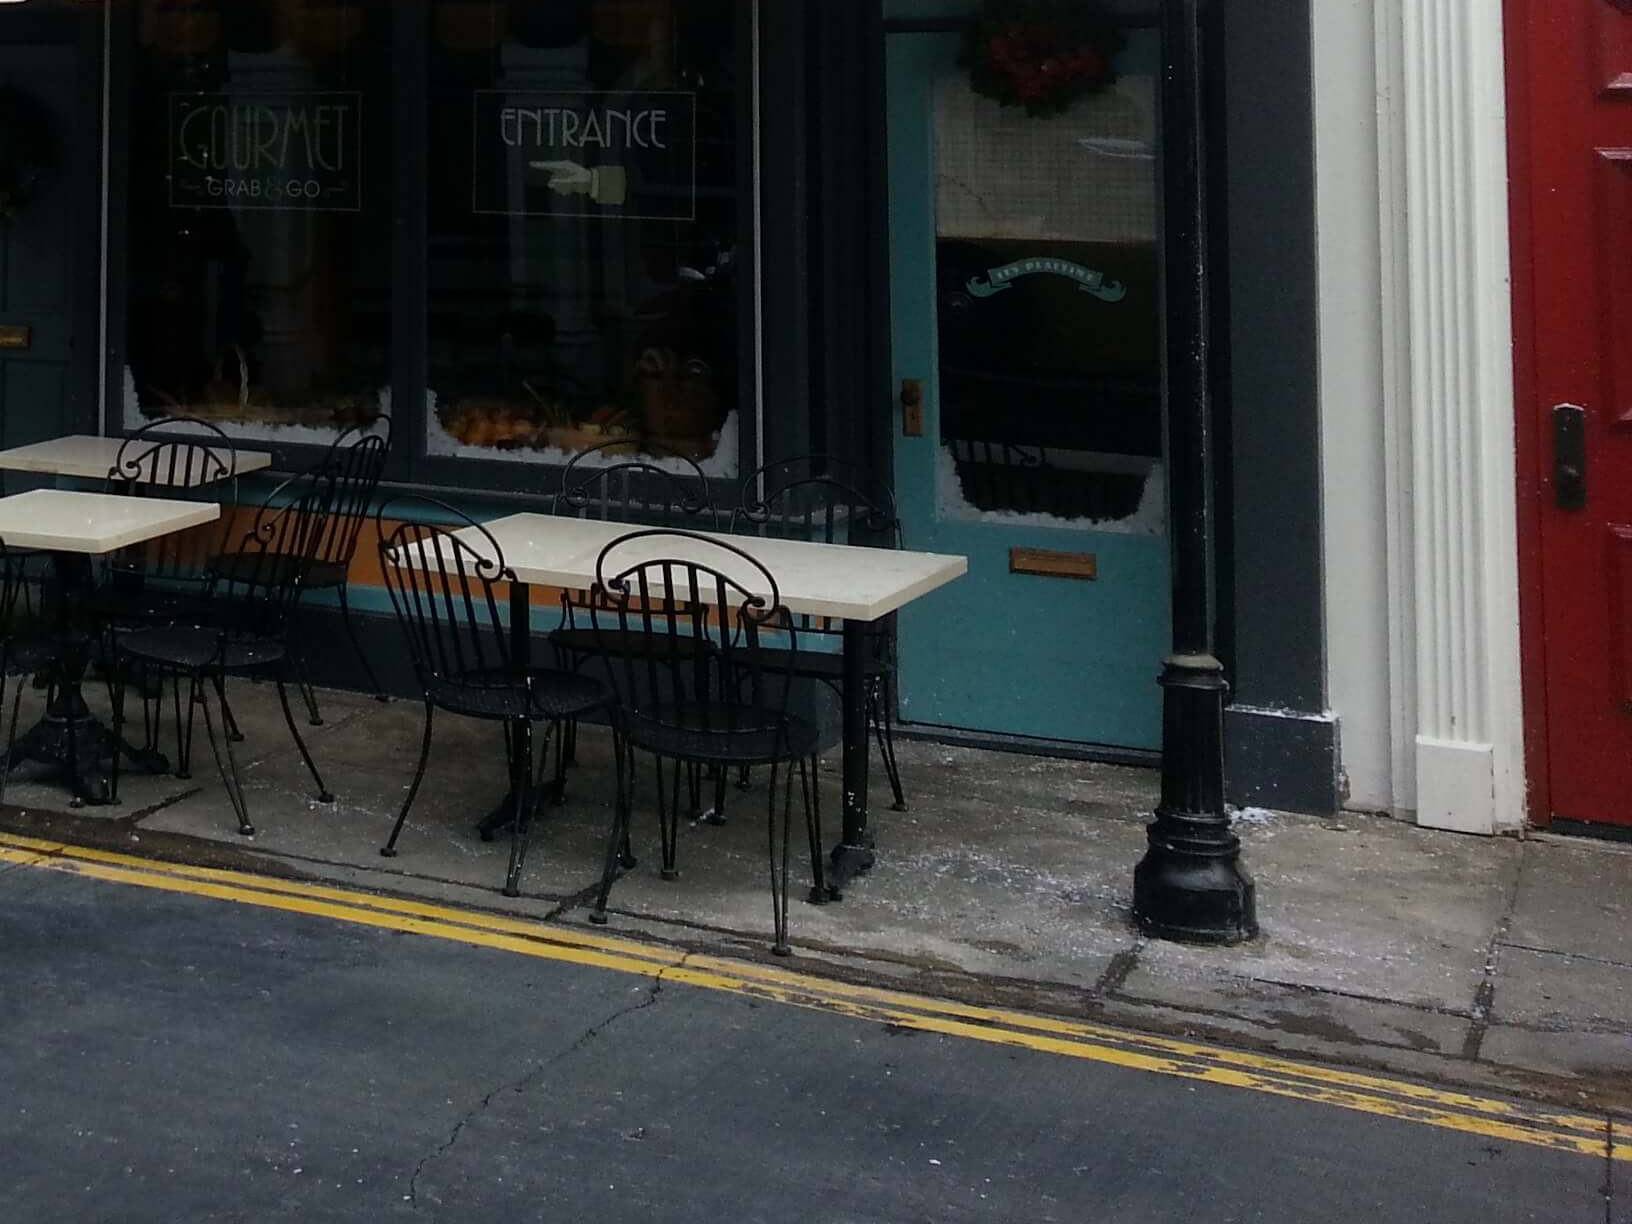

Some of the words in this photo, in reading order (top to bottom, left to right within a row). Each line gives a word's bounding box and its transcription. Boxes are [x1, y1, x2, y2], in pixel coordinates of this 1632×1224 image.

[176, 103, 350, 172] GOURMET
[499, 107, 667, 150] ENTRANCE
[207, 178, 263, 197] GRAB
[286, 178, 321, 198] GO
